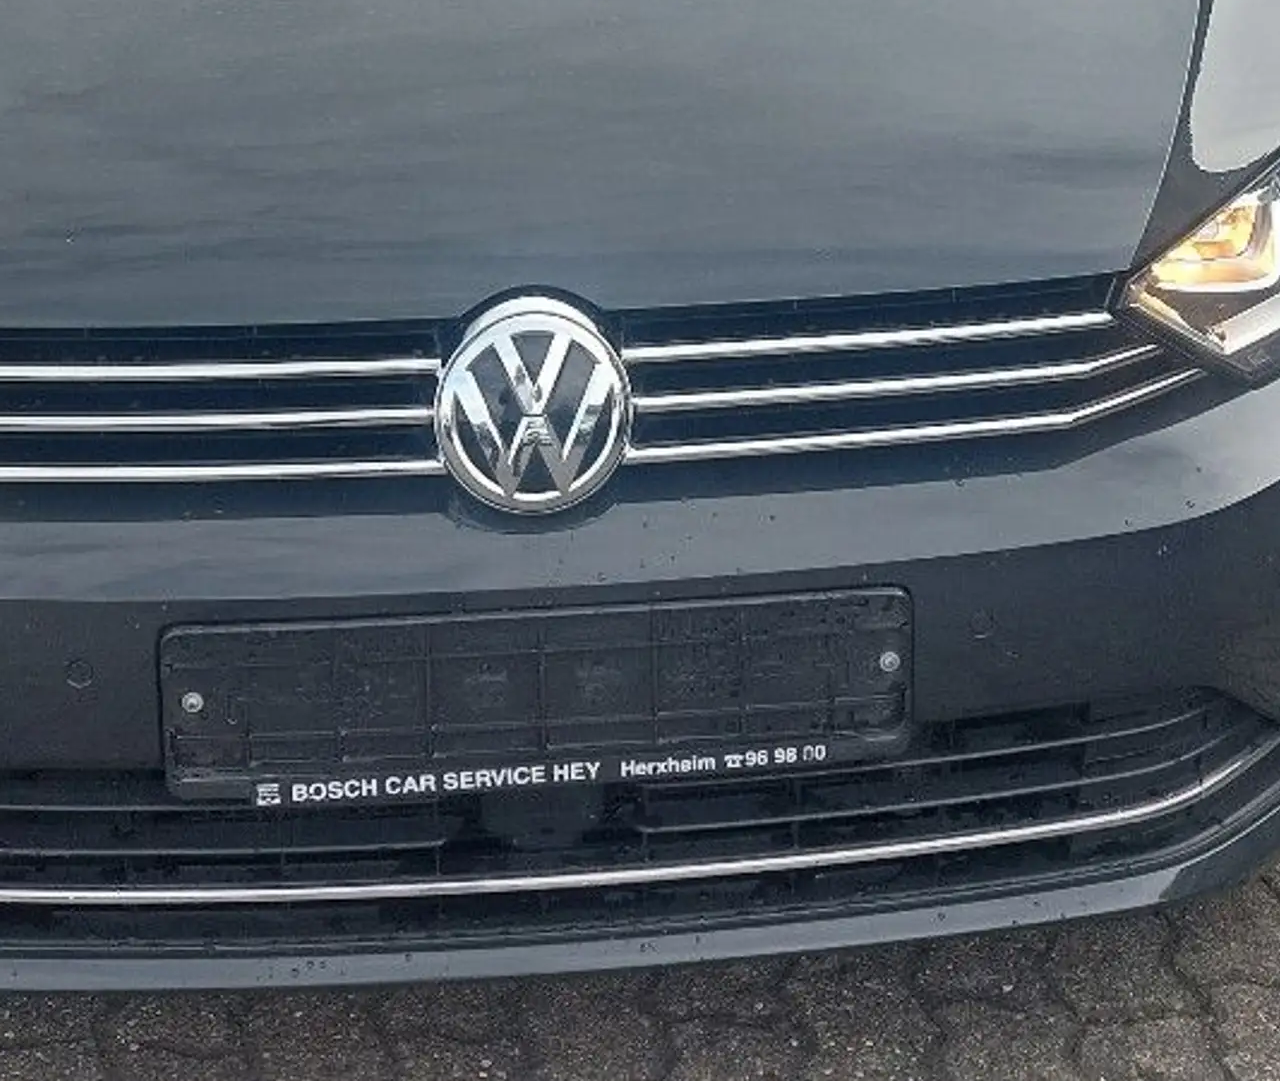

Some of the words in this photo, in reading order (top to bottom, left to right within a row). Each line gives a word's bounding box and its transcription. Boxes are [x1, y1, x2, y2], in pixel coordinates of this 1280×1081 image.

[291, 778, 378, 803] BOSCH
[385, 773, 437, 796] CAR
[443, 765, 546, 791] SERVICE
[553, 761, 602, 783] HEY
[620, 754, 717, 778] Herxheim
[774, 747, 798, 764] 98
